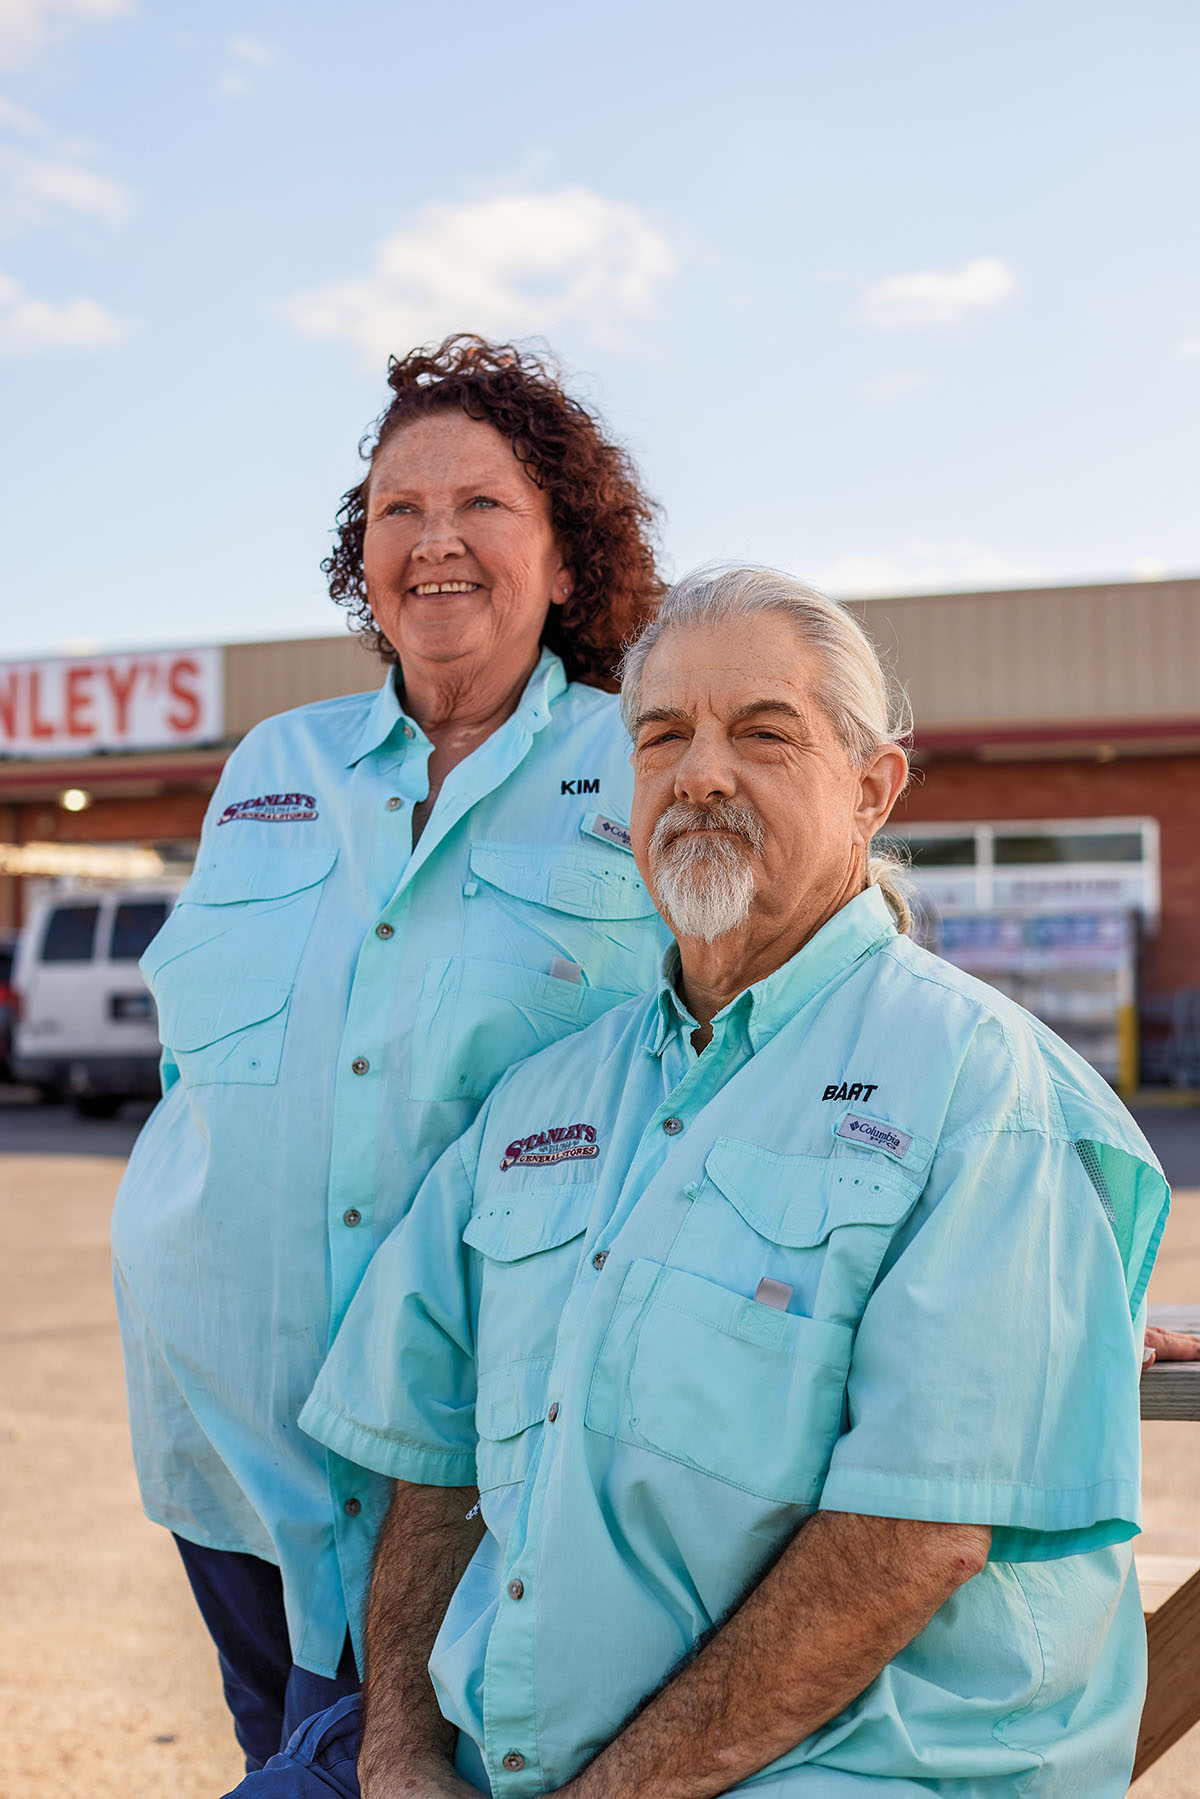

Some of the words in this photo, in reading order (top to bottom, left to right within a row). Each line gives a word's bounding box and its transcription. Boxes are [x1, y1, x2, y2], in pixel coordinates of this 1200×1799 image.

[561, 779, 600, 795] KIM
[221, 793, 316, 818] STANLEY'S
[822, 1082, 878, 1102] BART
[503, 1123, 597, 1160] STANLEY'S
[859, 1123, 901, 1147] Columbia
[519, 1153, 562, 1163] GENERAL
[561, 1146, 596, 1159] STORES
